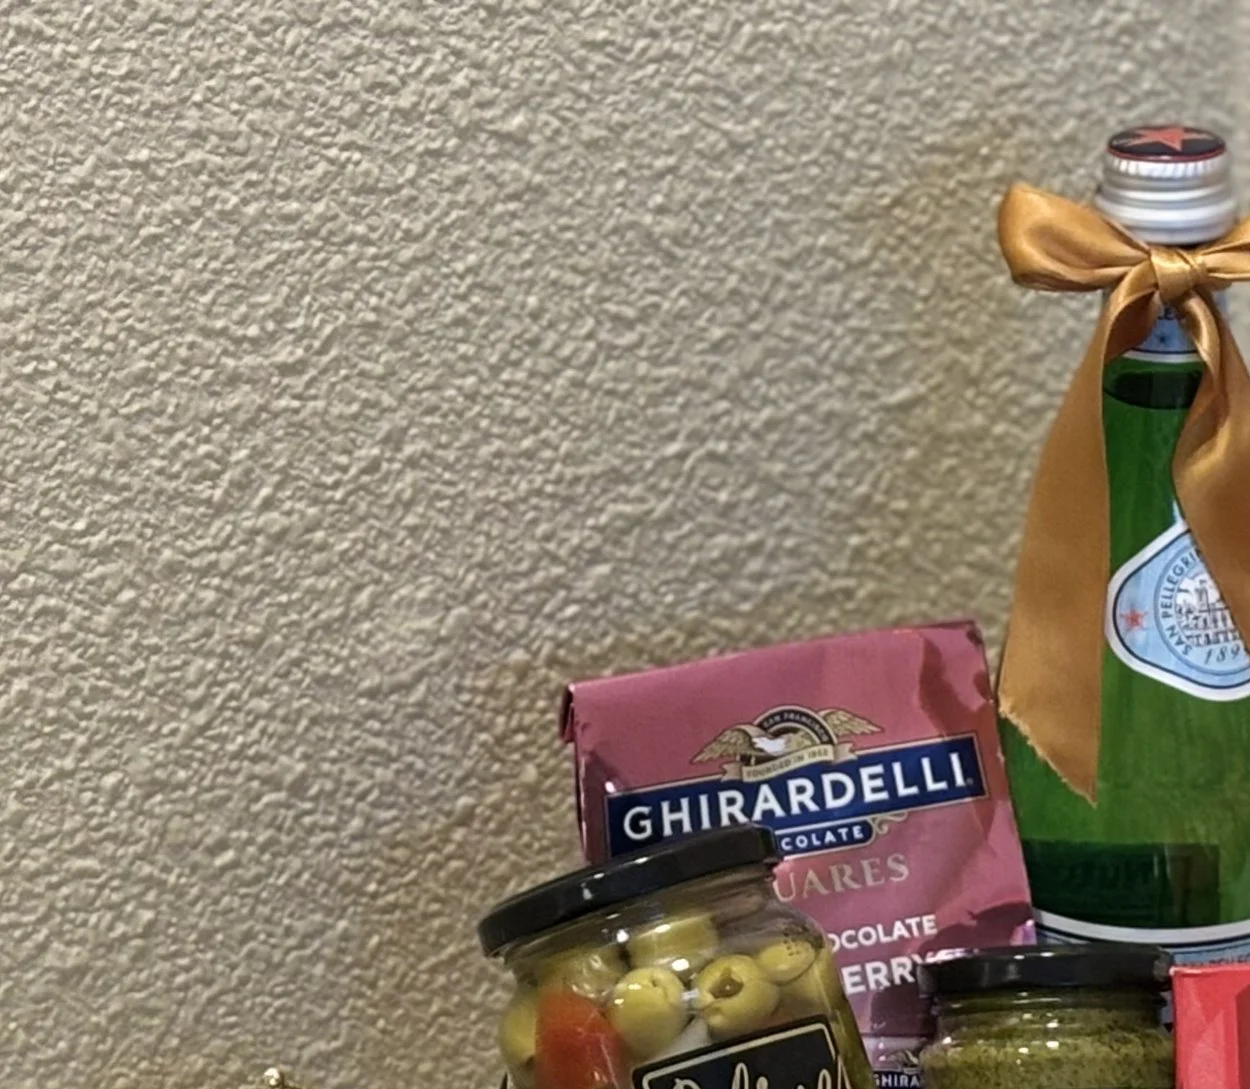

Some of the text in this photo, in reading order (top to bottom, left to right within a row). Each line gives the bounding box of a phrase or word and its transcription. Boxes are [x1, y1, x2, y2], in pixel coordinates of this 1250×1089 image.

[1160, 550, 1199, 656] SAN PELLEGRI
[1203, 644, 1241, 665] 189
[622, 751, 968, 841] GHIRARDELLI
[780, 826, 865, 851] COLATE
[772, 853, 910, 902] UARES
[827, 914, 939, 953] OCOLATE
